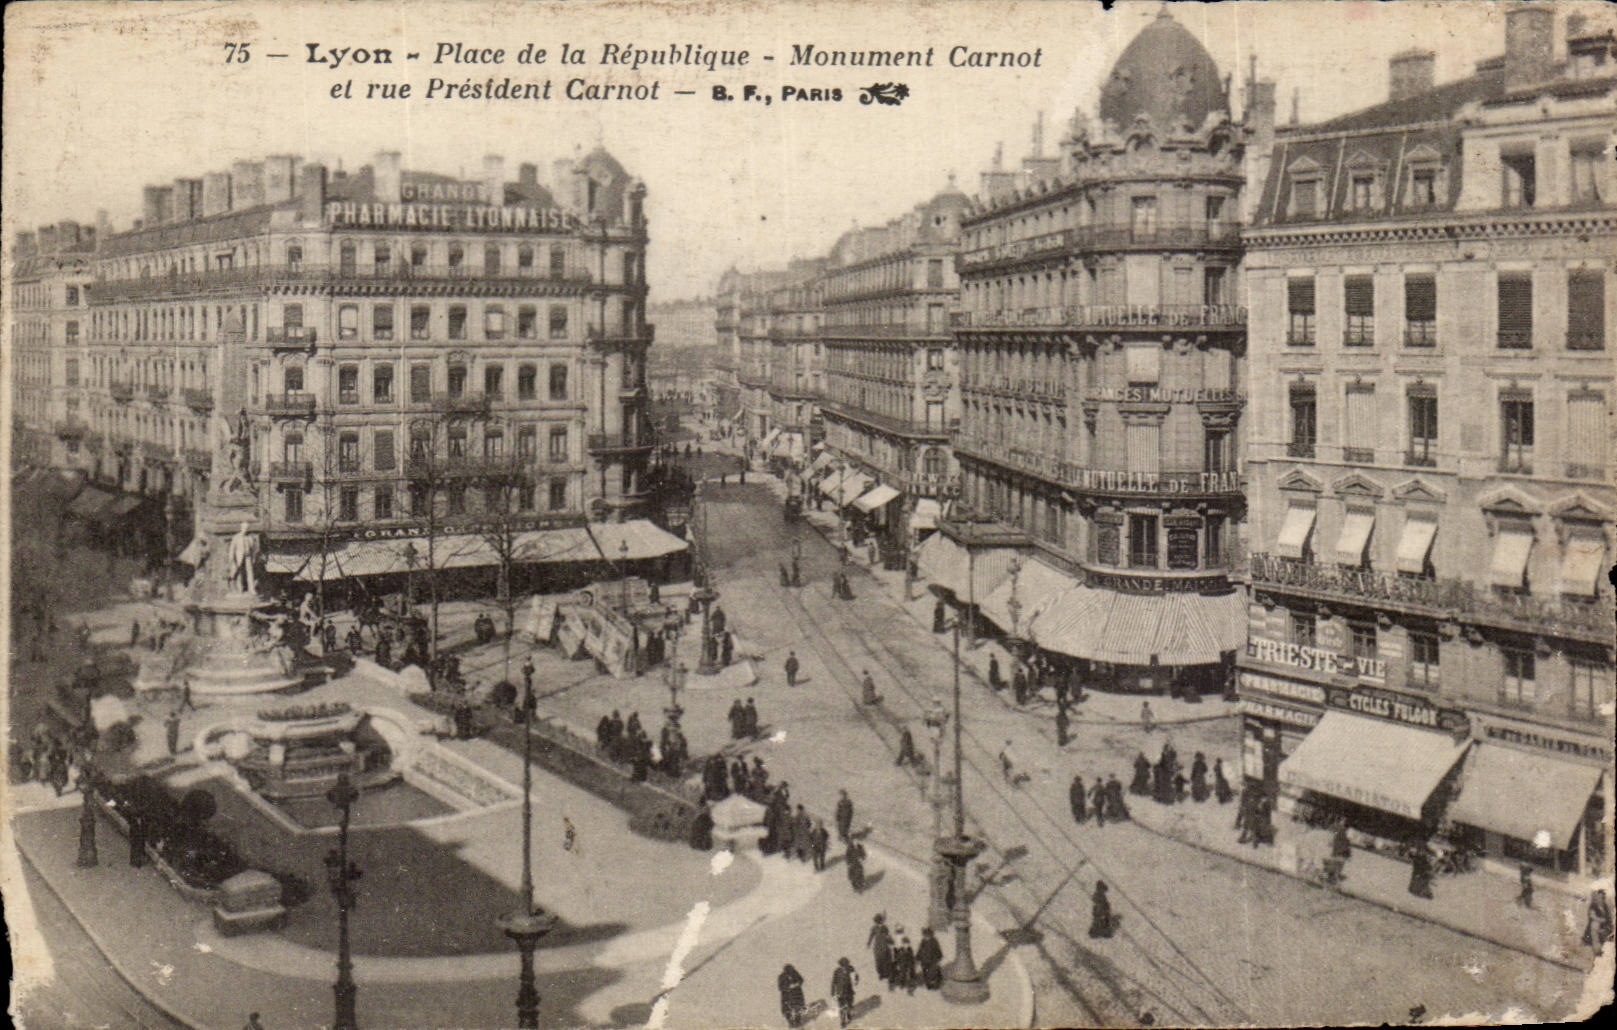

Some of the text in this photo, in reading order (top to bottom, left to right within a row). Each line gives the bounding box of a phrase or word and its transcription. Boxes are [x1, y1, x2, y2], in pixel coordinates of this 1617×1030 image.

[328, 201, 573, 231] PHARMACIE LYONNAISE
[1253, 635, 1339, 674] TRIESTE
